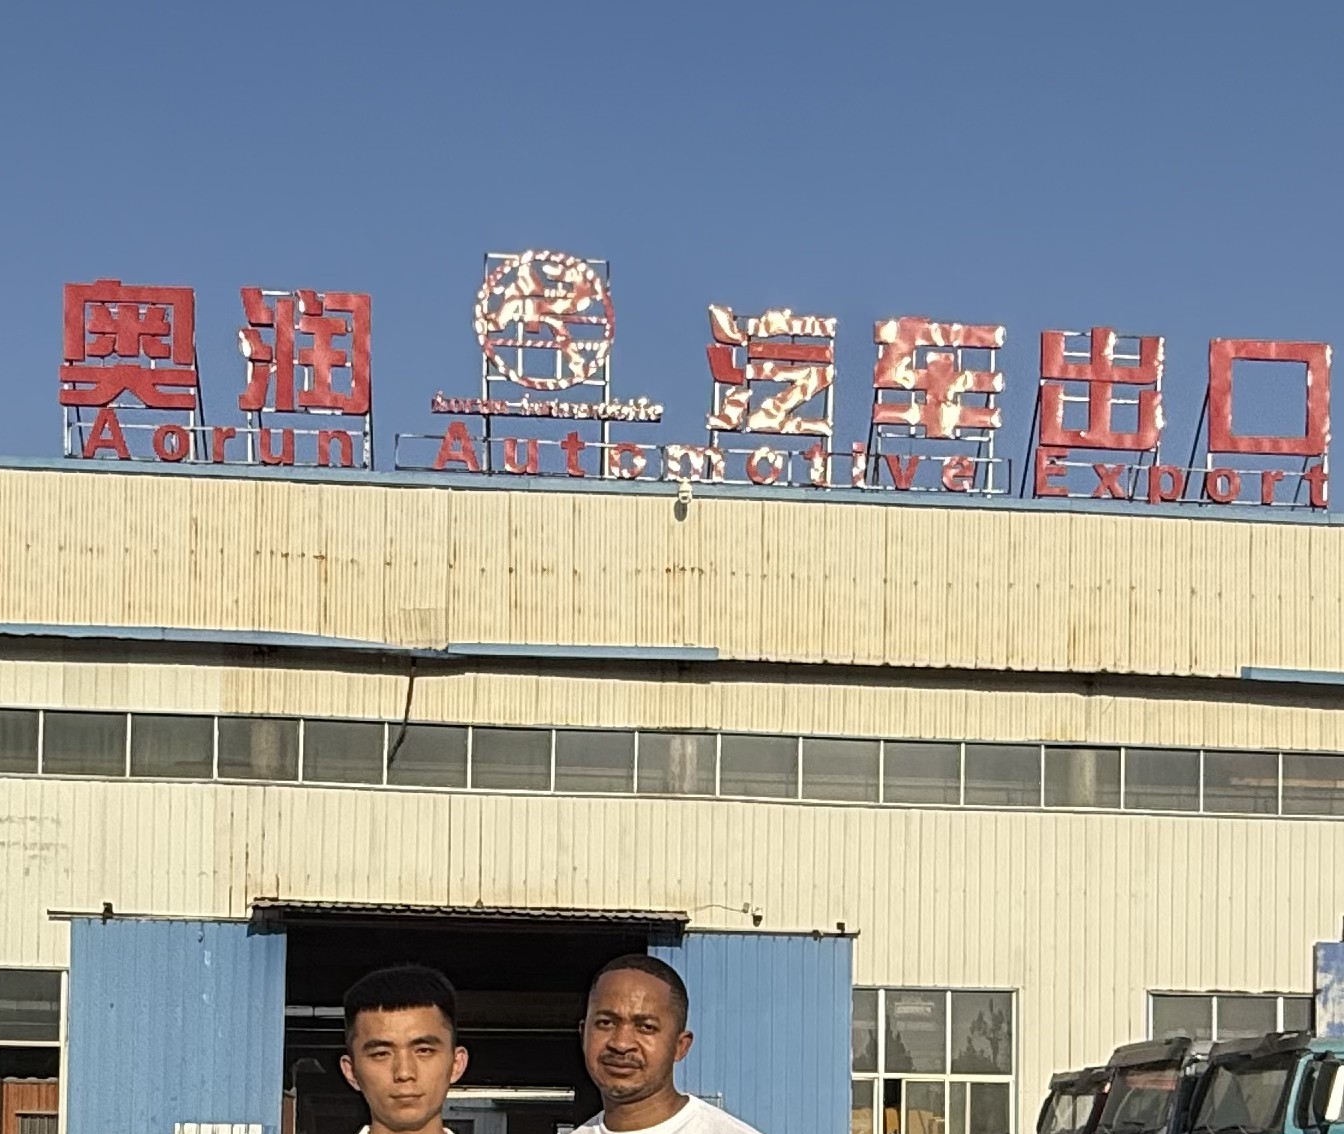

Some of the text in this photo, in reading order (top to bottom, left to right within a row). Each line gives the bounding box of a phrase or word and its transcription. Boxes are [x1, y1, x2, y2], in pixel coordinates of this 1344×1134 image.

[59, 278, 1334, 457] 奥润 汽车出口
[82, 407, 1330, 507] Aorun Automotive Export
